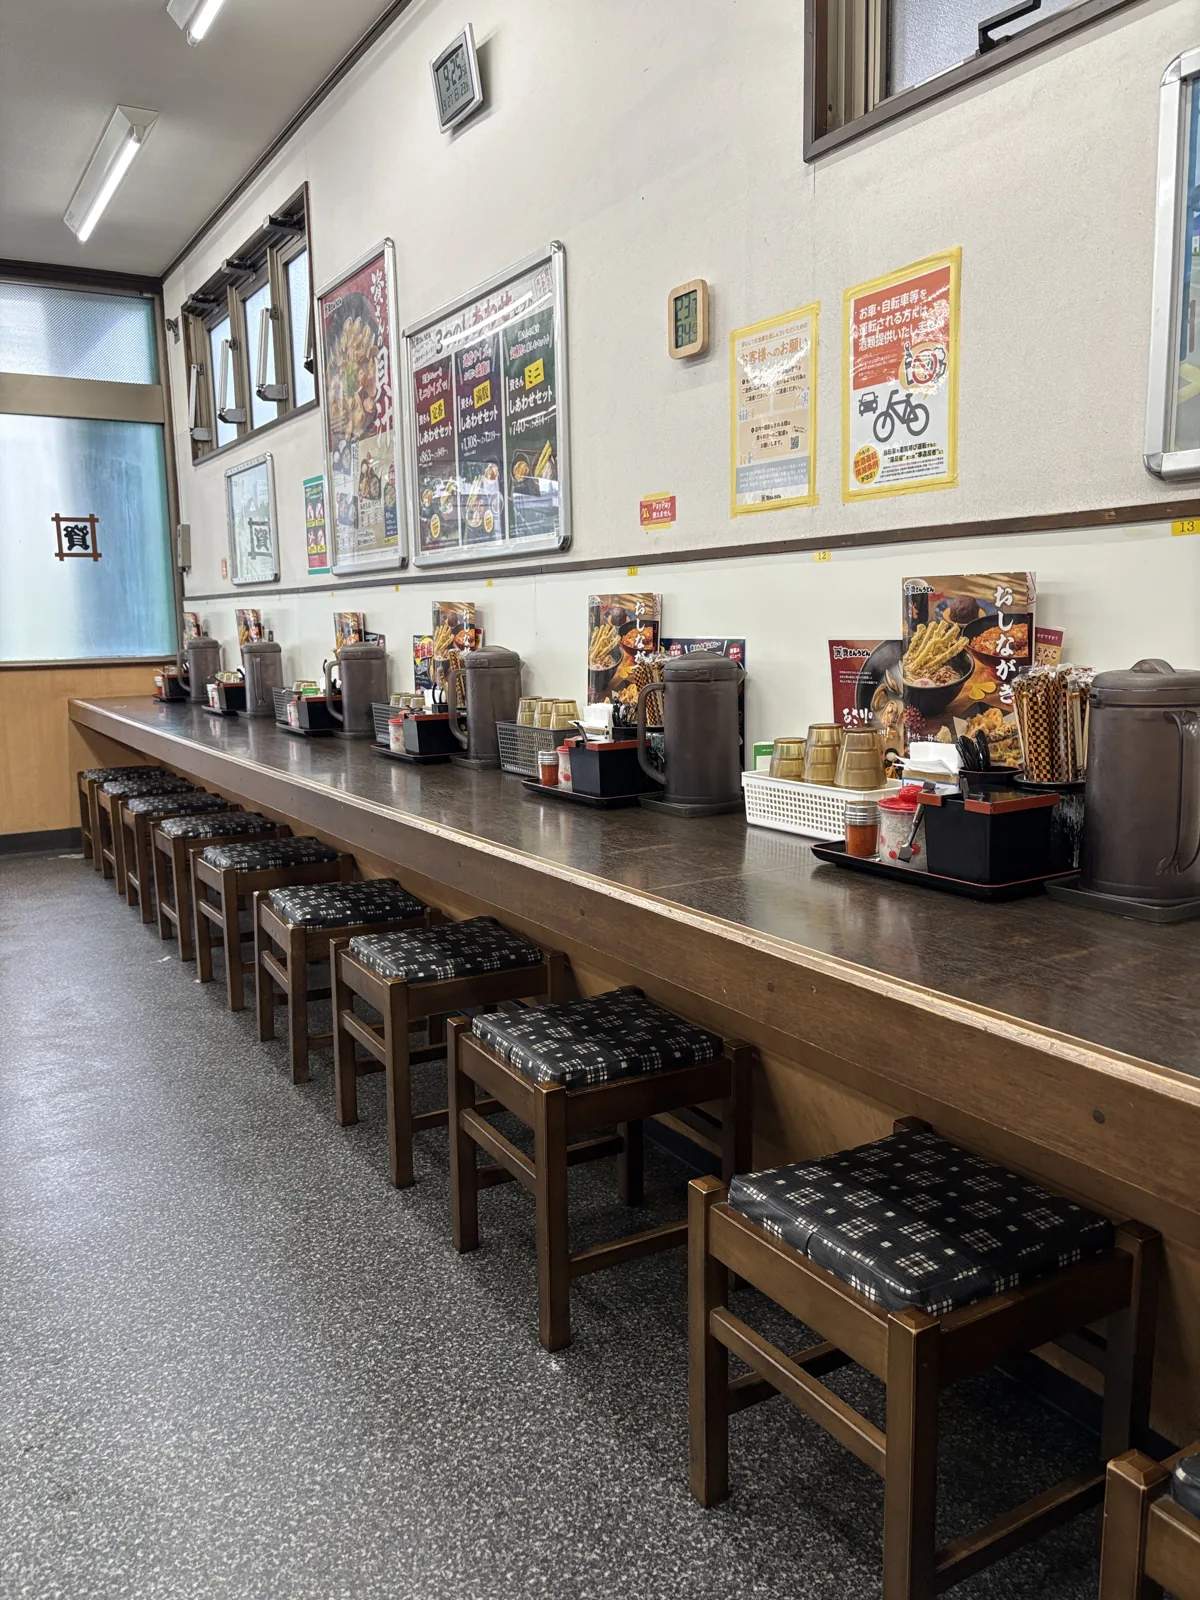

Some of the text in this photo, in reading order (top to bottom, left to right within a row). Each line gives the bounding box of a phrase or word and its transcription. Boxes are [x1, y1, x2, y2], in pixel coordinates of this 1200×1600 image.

[859, 288, 927, 320] お車・自転車等を
[859, 305, 928, 337] 運転される方には
[740, 336, 808, 367] お客様へのお願い
[509, 367, 541, 392] 資さん ミニ
[509, 385, 553, 413] しあわせセット
[461, 405, 498, 431] しあわせセット
[419, 421, 452, 446] しあわせセット
[652, 501, 671, 510] PayPay
[1179, 521, 1195, 532] 13
[817, 552, 827, 560] 12
[634, 601, 647, 669] おしなが
[994, 585, 1015, 706] おしながき
